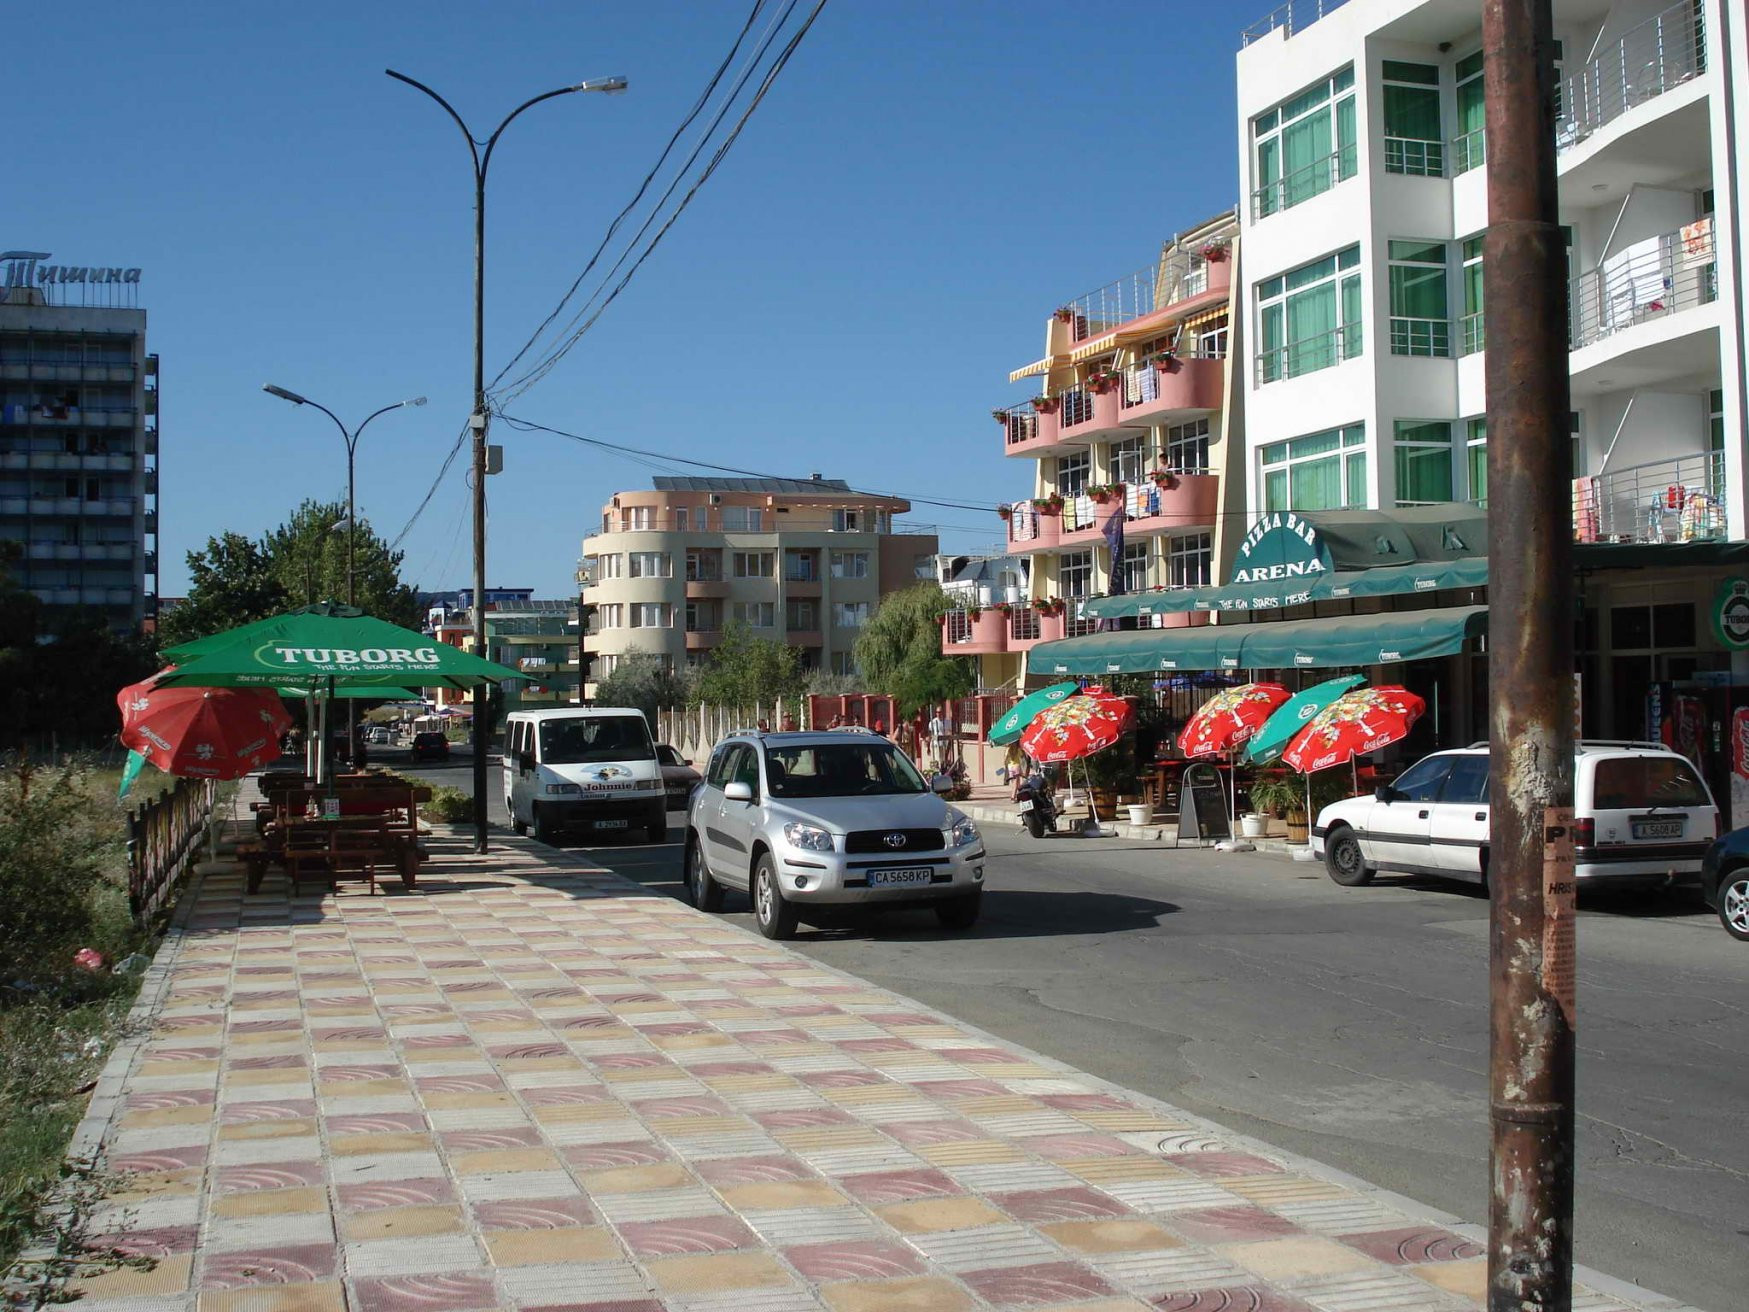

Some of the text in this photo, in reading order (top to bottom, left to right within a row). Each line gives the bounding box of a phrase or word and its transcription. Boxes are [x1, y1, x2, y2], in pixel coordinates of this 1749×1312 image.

[1241, 513, 1315, 557] PIZZA BAR
[1234, 558, 1326, 582] ARENA
[1219, 600, 1232, 610] THE
[1252, 597, 1278, 608] STARTS
[1285, 591, 1311, 605] HERE
[275, 647, 440, 664] TUBORG
[314, 663, 336, 671] THE
[340, 663, 360, 671] FUN
[365, 663, 403, 671] STARTS
[584, 782, 632, 792] Johnnie
[876, 870, 930, 883] CA 5658 KP
